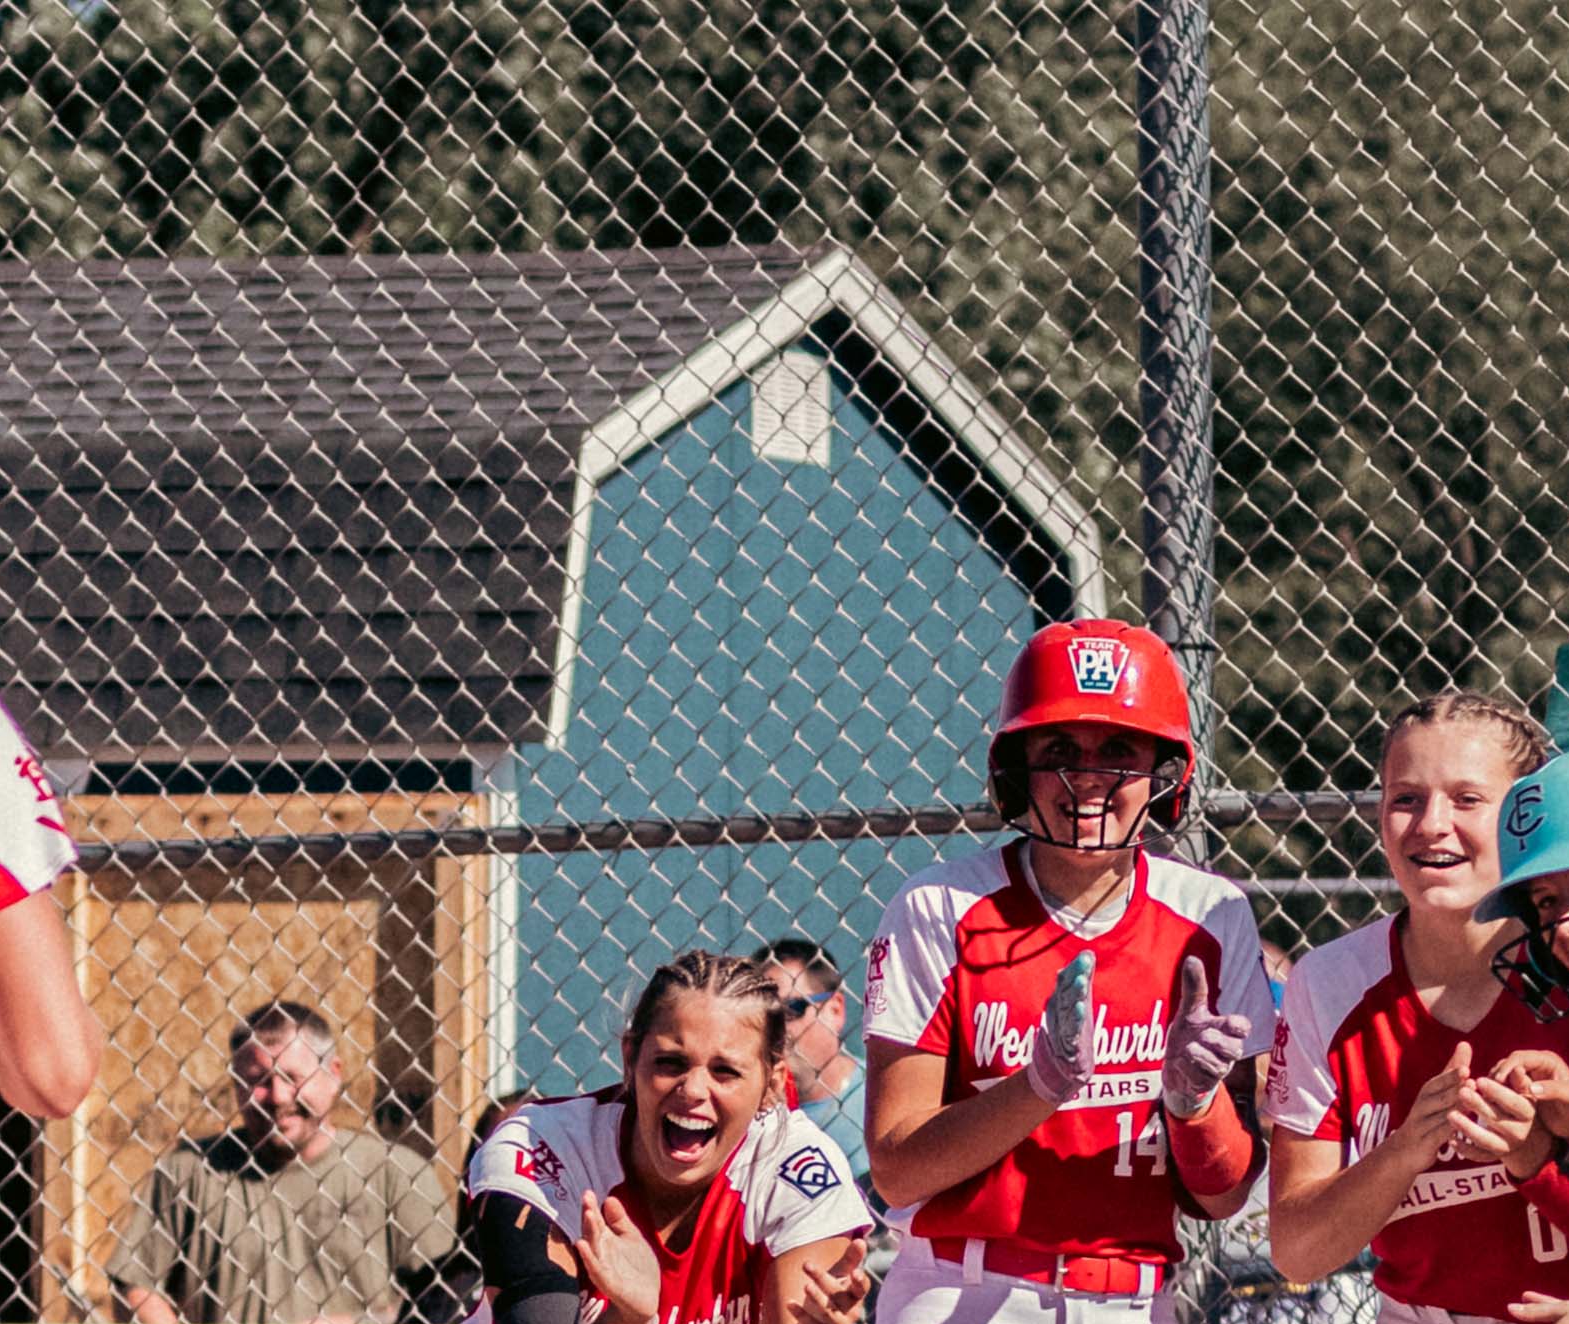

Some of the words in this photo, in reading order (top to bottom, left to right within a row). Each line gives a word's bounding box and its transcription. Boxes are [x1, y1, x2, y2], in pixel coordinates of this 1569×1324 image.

[1078, 649, 1116, 682] PA
[1114, 1111, 1168, 1177] 14
[1400, 1171, 1510, 1209] ALL-STA
